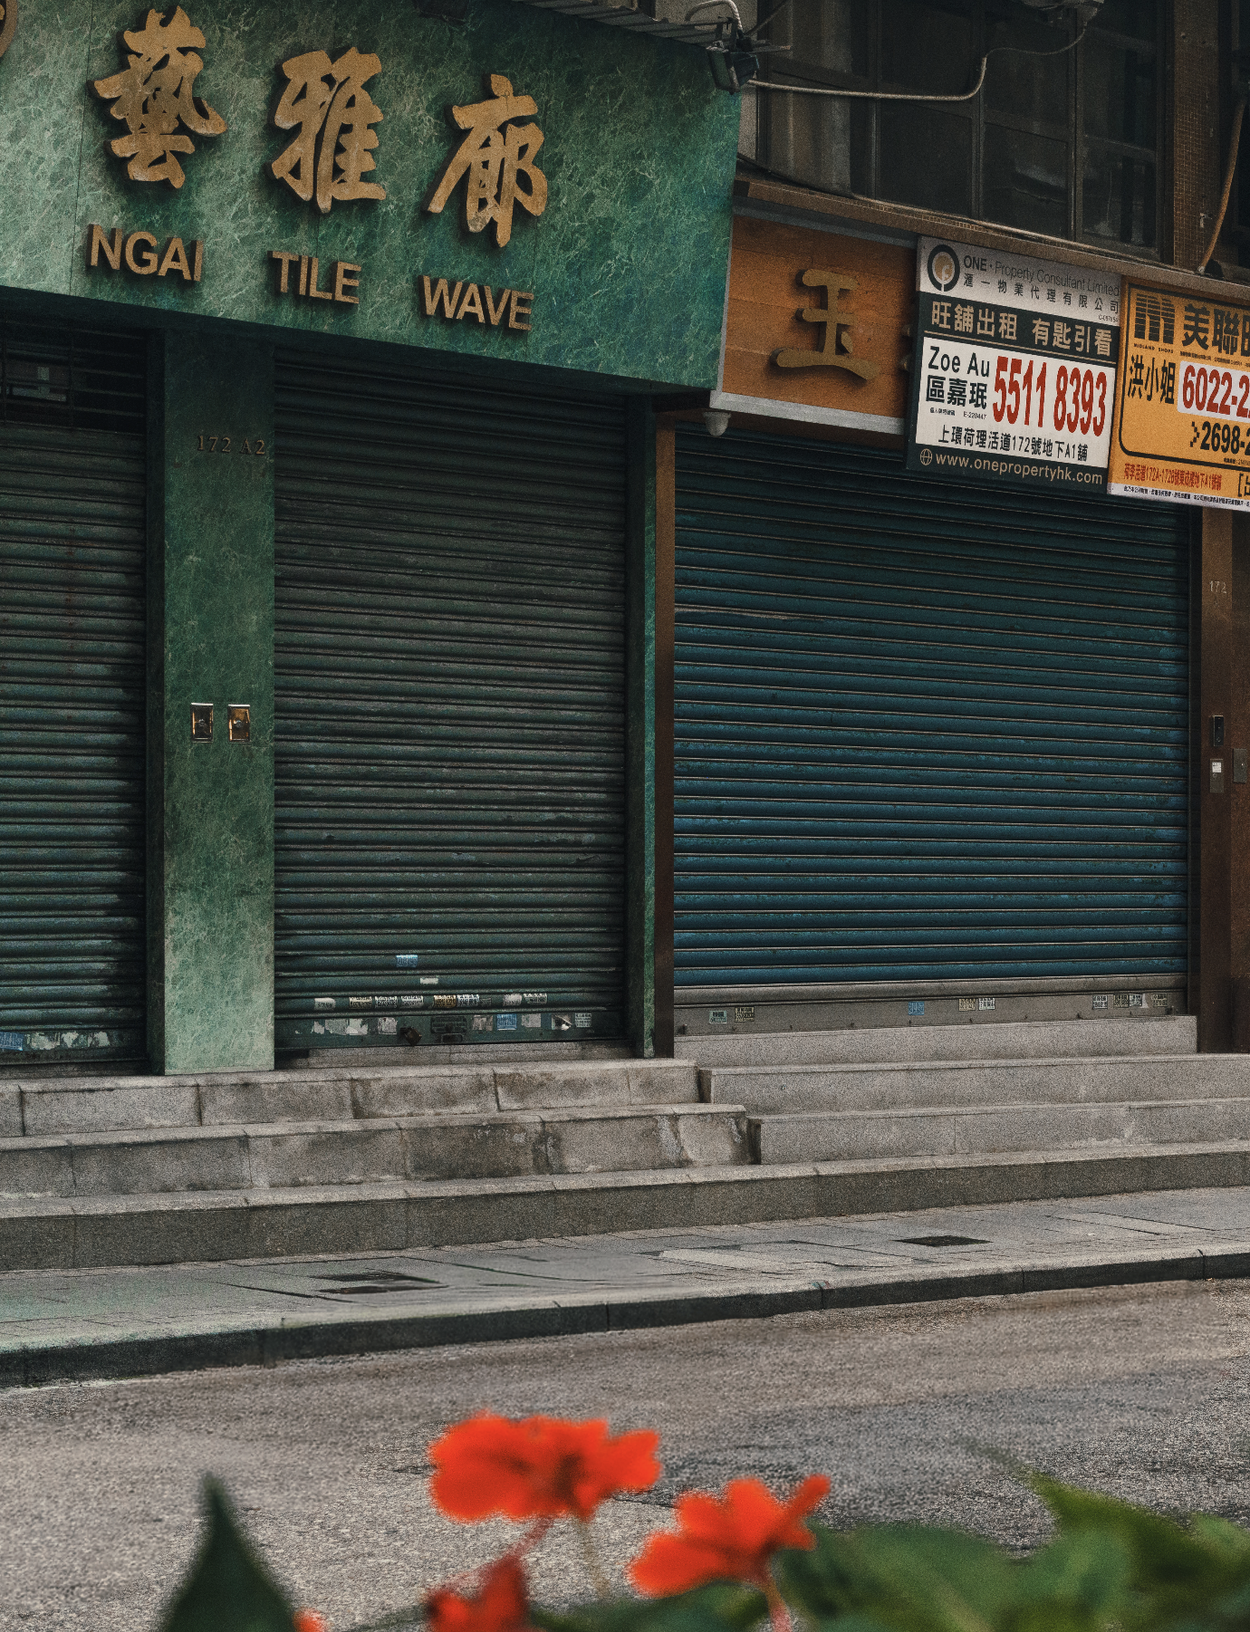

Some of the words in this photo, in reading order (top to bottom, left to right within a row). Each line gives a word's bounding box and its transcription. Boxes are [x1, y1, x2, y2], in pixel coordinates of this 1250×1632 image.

[92, 4, 549, 248] 藝雅廊
[87, 223, 202, 283] NGAI
[268, 250, 361, 304] TILE
[420, 275, 533, 333] WAVE
[963, 255, 987, 272] ONE
[995, 260, 1035, 283] Property
[1037, 269, 1085, 288] Consultant
[1087, 278, 1120, 297] Limited
[771, 268, 872, 381] 玉
[931, 301, 1018, 341] 旺舖出租
[1032, 318, 1112, 357] 有匙引看
[928, 346, 961, 373] Zoe
[967, 353, 990, 378] Au
[1127, 354, 1176, 404] 洪小姐
[926, 375, 988, 410] 區嘉珉
[993, 356, 1047, 428] 5511
[1054, 365, 1107, 437] 8393
[198, 435, 231, 453] 172
[936, 453, 1103, 485] www.onepropertyhk.com
[1210, 580, 1227, 594] 172
